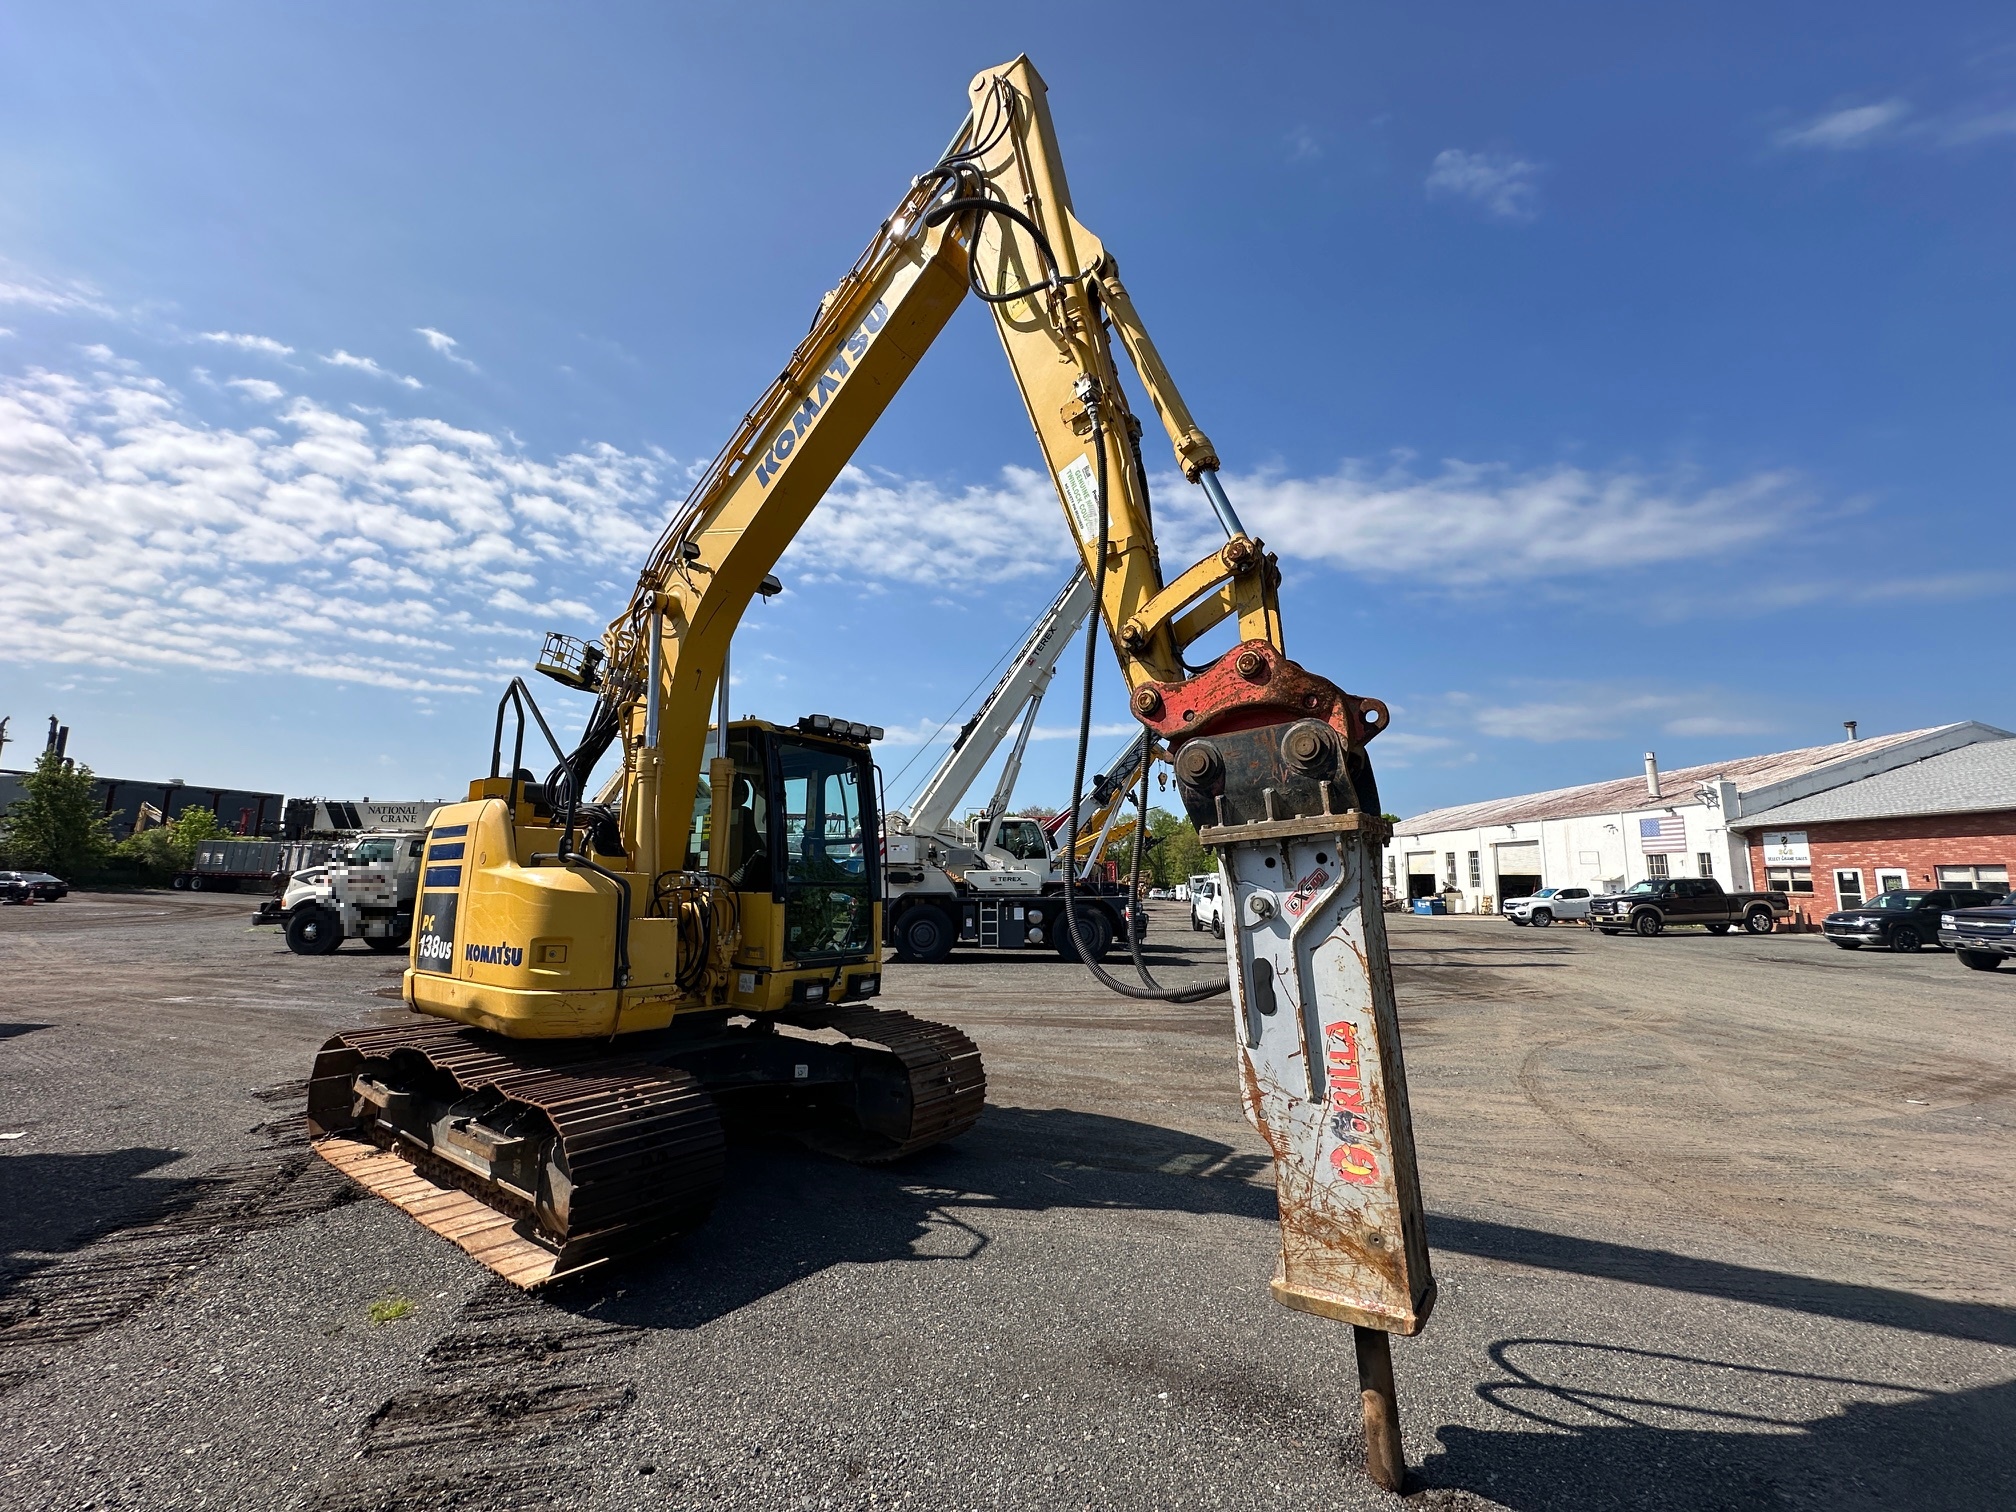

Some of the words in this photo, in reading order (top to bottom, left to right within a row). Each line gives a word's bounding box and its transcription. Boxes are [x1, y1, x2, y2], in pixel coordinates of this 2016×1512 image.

[754, 300, 889, 489] KOMATSU
[1066, 469, 1083, 504] TWINLOCK
[1075, 469, 1090, 500] GENUINE
[1032, 626, 1057, 656] TEREX
[368, 806, 418, 815] NATIONAL
[381, 815, 417, 823] CRANE
[422, 914, 436, 932] PC
[466, 941, 523, 967] KOMATSU
[1325, 1021, 1381, 1185] GORILLA
